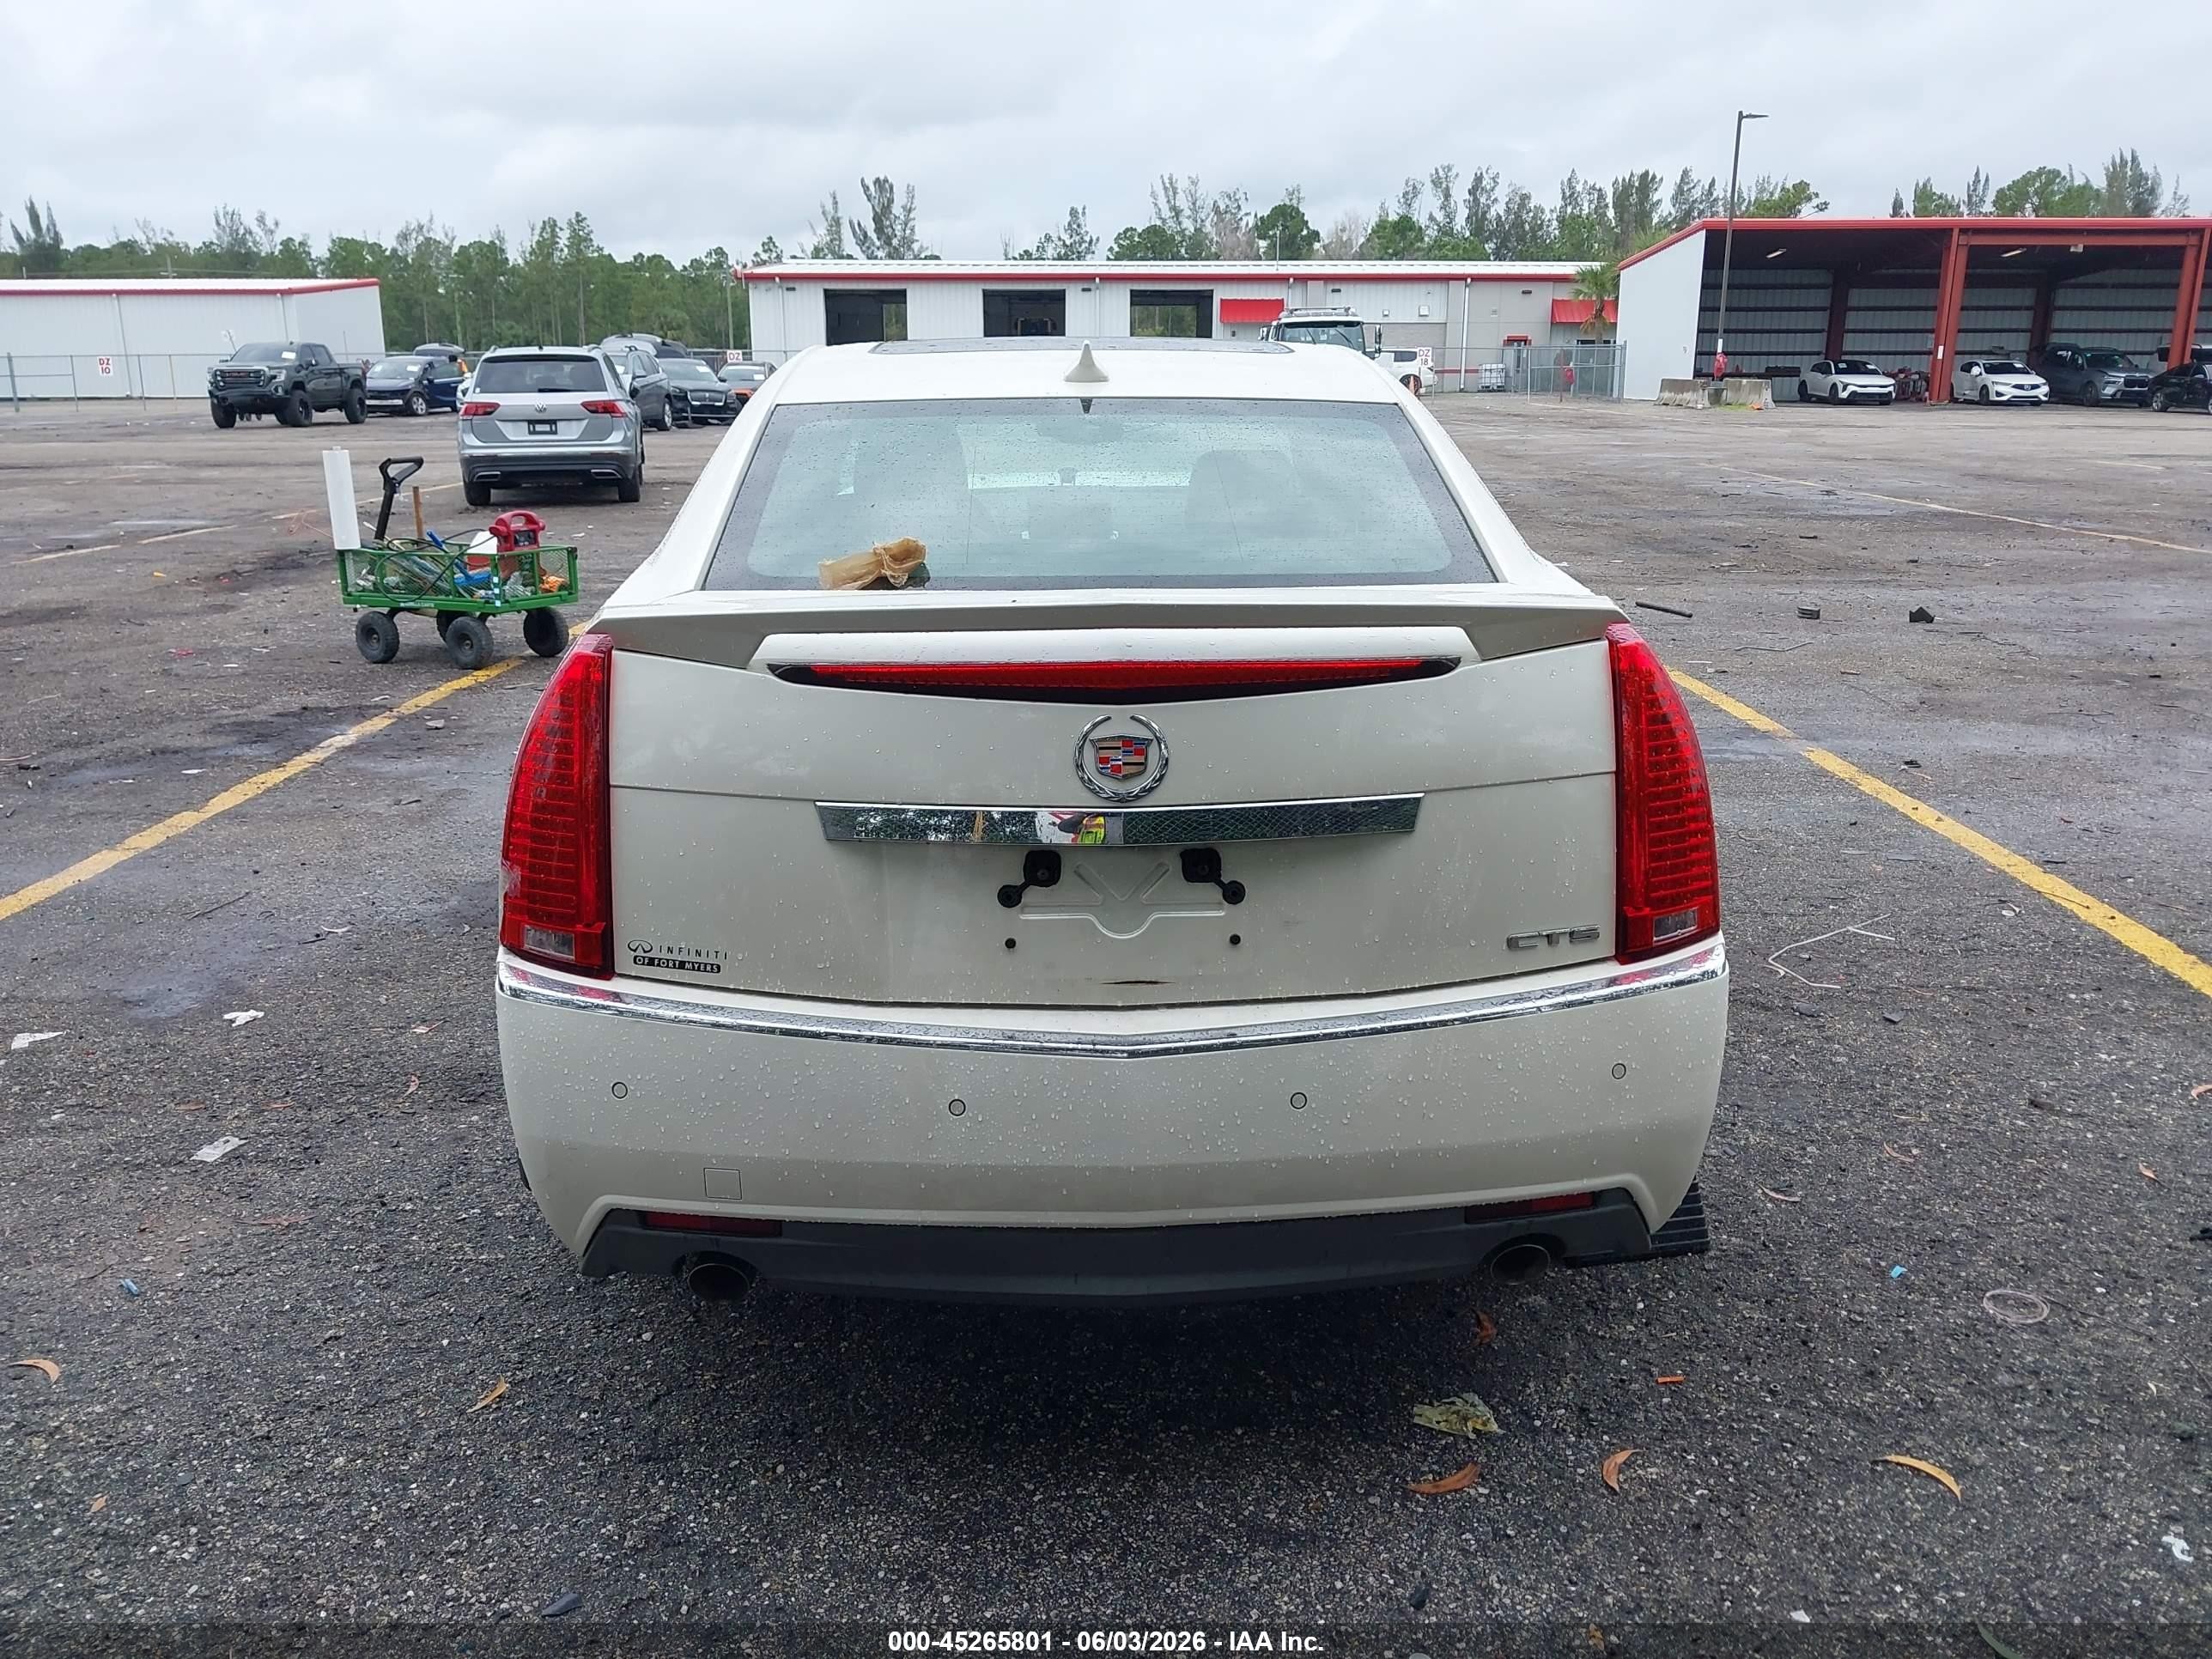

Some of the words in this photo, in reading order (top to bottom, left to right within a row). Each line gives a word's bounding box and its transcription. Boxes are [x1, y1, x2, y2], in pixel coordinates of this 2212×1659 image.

[728, 352, 742, 361] DZ
[1419, 349, 1430, 357] DZ
[99, 357, 111, 366] DZ
[1506, 925, 1601, 950] CTS
[659, 945, 728, 961] INFINITI
[635, 956, 649, 965] OF
[654, 958, 680, 969] FORT
[684, 962, 719, 973] MYERS
